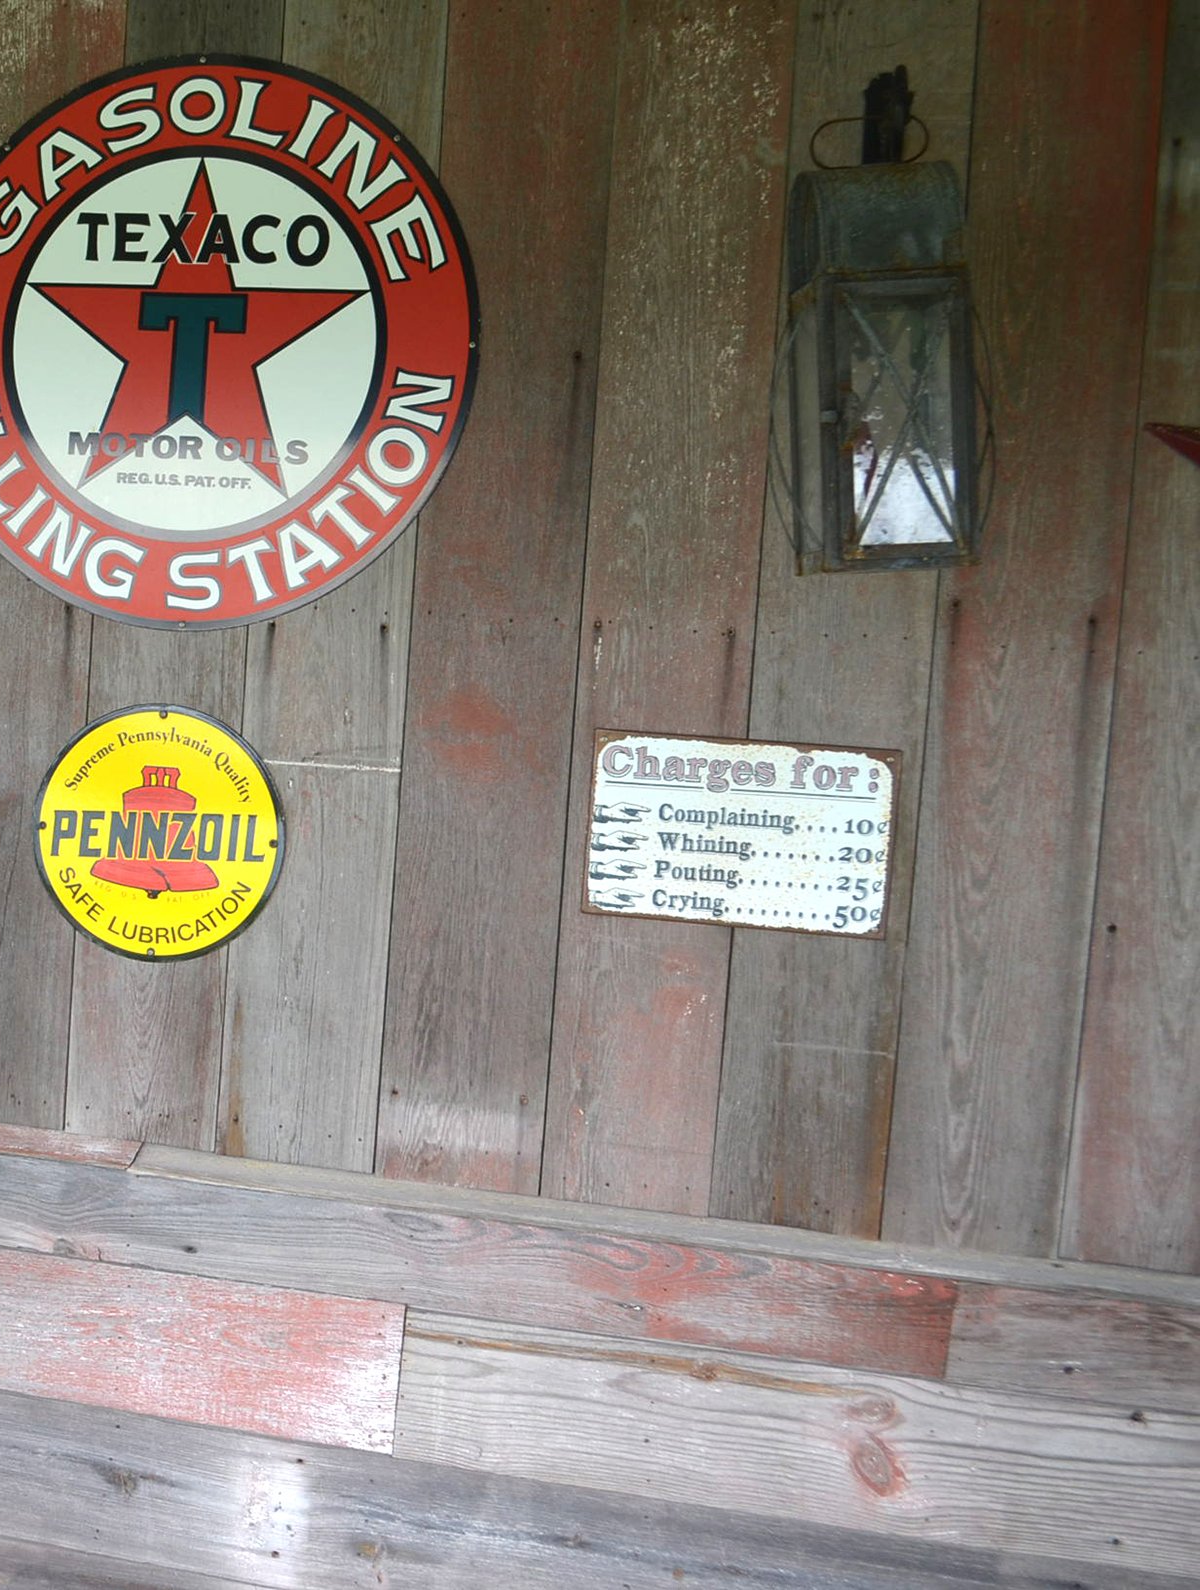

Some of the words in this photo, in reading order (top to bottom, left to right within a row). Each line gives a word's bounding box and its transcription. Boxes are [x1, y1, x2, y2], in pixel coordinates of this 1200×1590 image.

[77, 212, 330, 267] TEXACO
[139, 292, 248, 424] T
[68, 431, 203, 461] MOTOR
[215, 437, 309, 465] OILS
[166, 368, 457, 613] STATION
[64, 741, 116, 791] Supreme
[117, 726, 213, 758] Pennsylvania
[215, 751, 253, 804] Quality
[602, 744, 776, 793] Charges
[50, 810, 266, 862] PENNZOIL
[59, 866, 106, 923] SAFE
[107, 881, 253, 945] LUBRICATION
